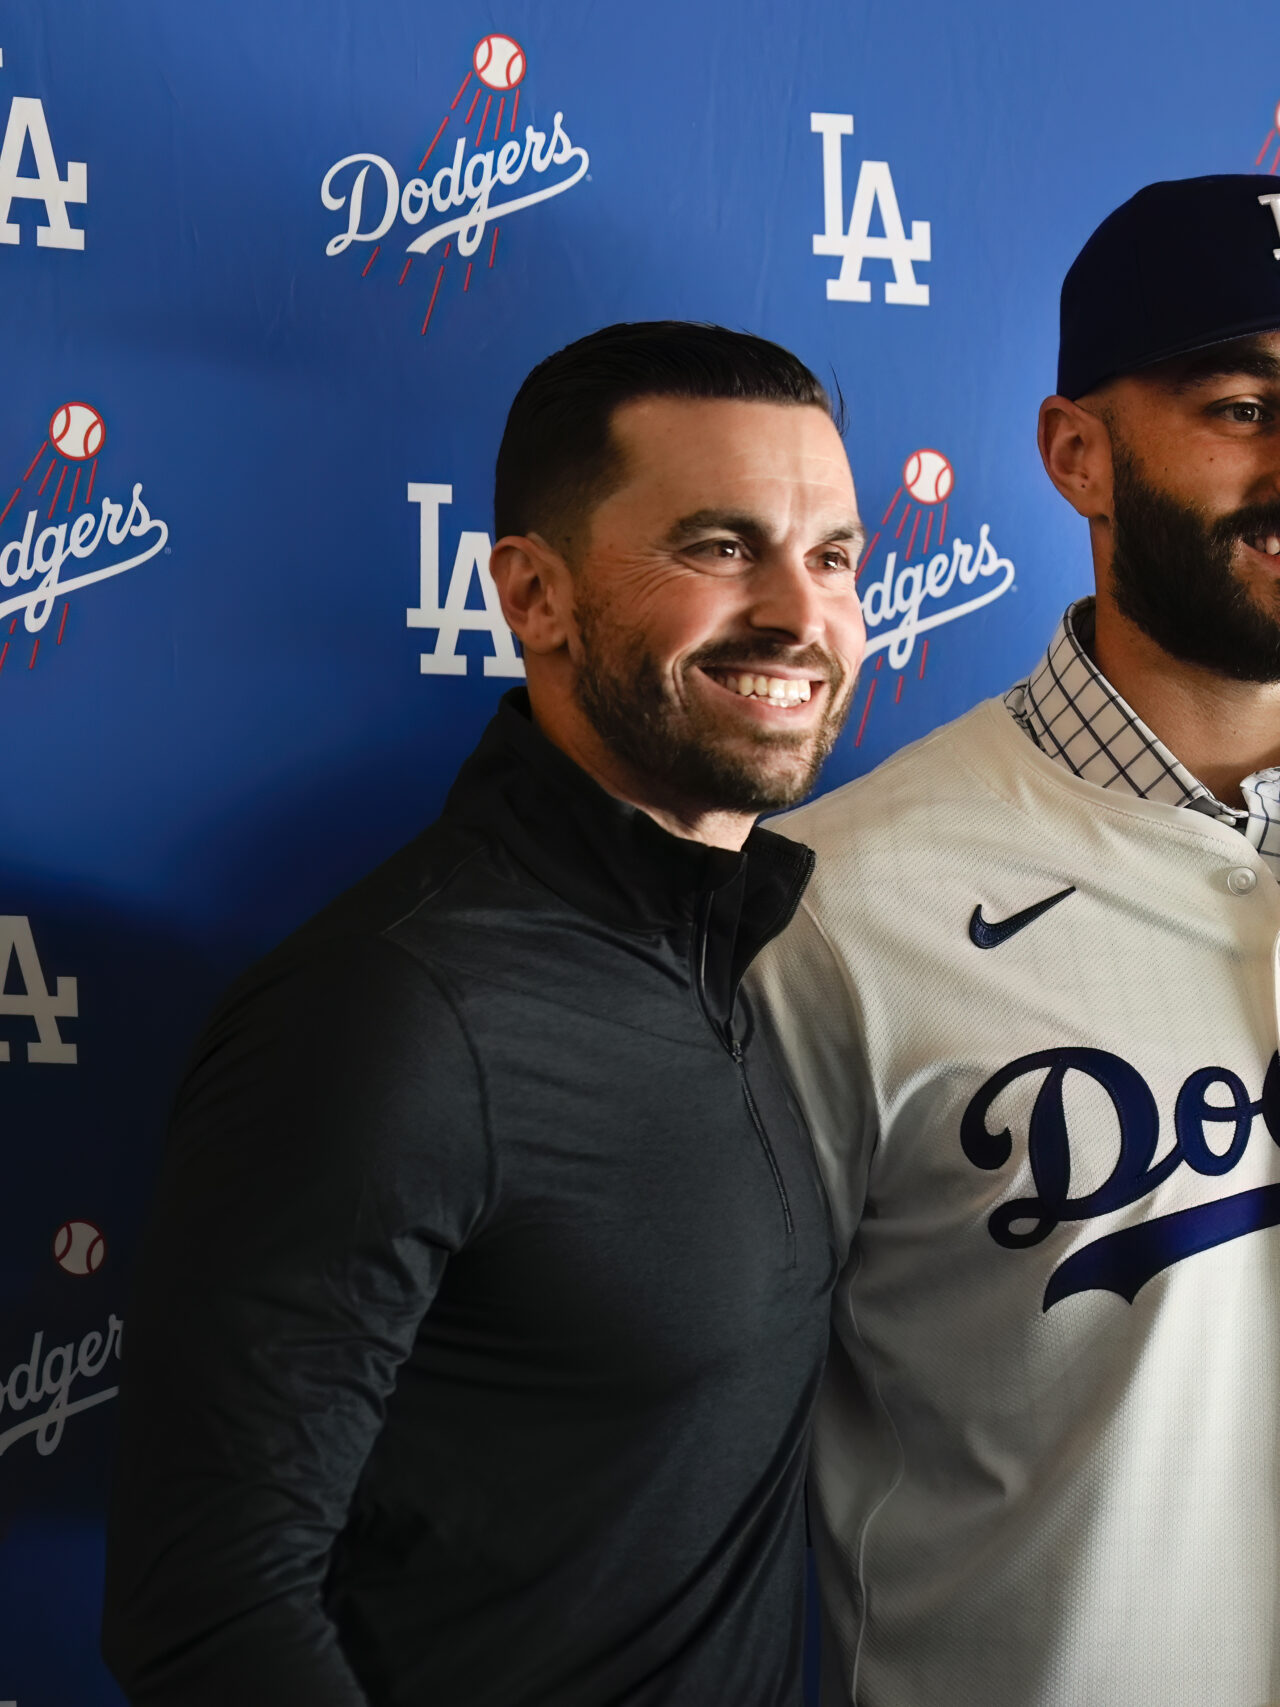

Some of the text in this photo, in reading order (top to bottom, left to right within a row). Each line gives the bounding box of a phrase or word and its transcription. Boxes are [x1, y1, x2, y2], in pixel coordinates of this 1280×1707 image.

[0, 48, 88, 250] A
[320, 111, 590, 257] Dodgers
[810, 112, 932, 306] LA
[0, 482, 169, 633] dgers
[406, 482, 518, 678] LA
[862, 523, 1015, 670] dgers
[0, 915, 78, 1064] A
[0, 1313, 124, 1457] dger
